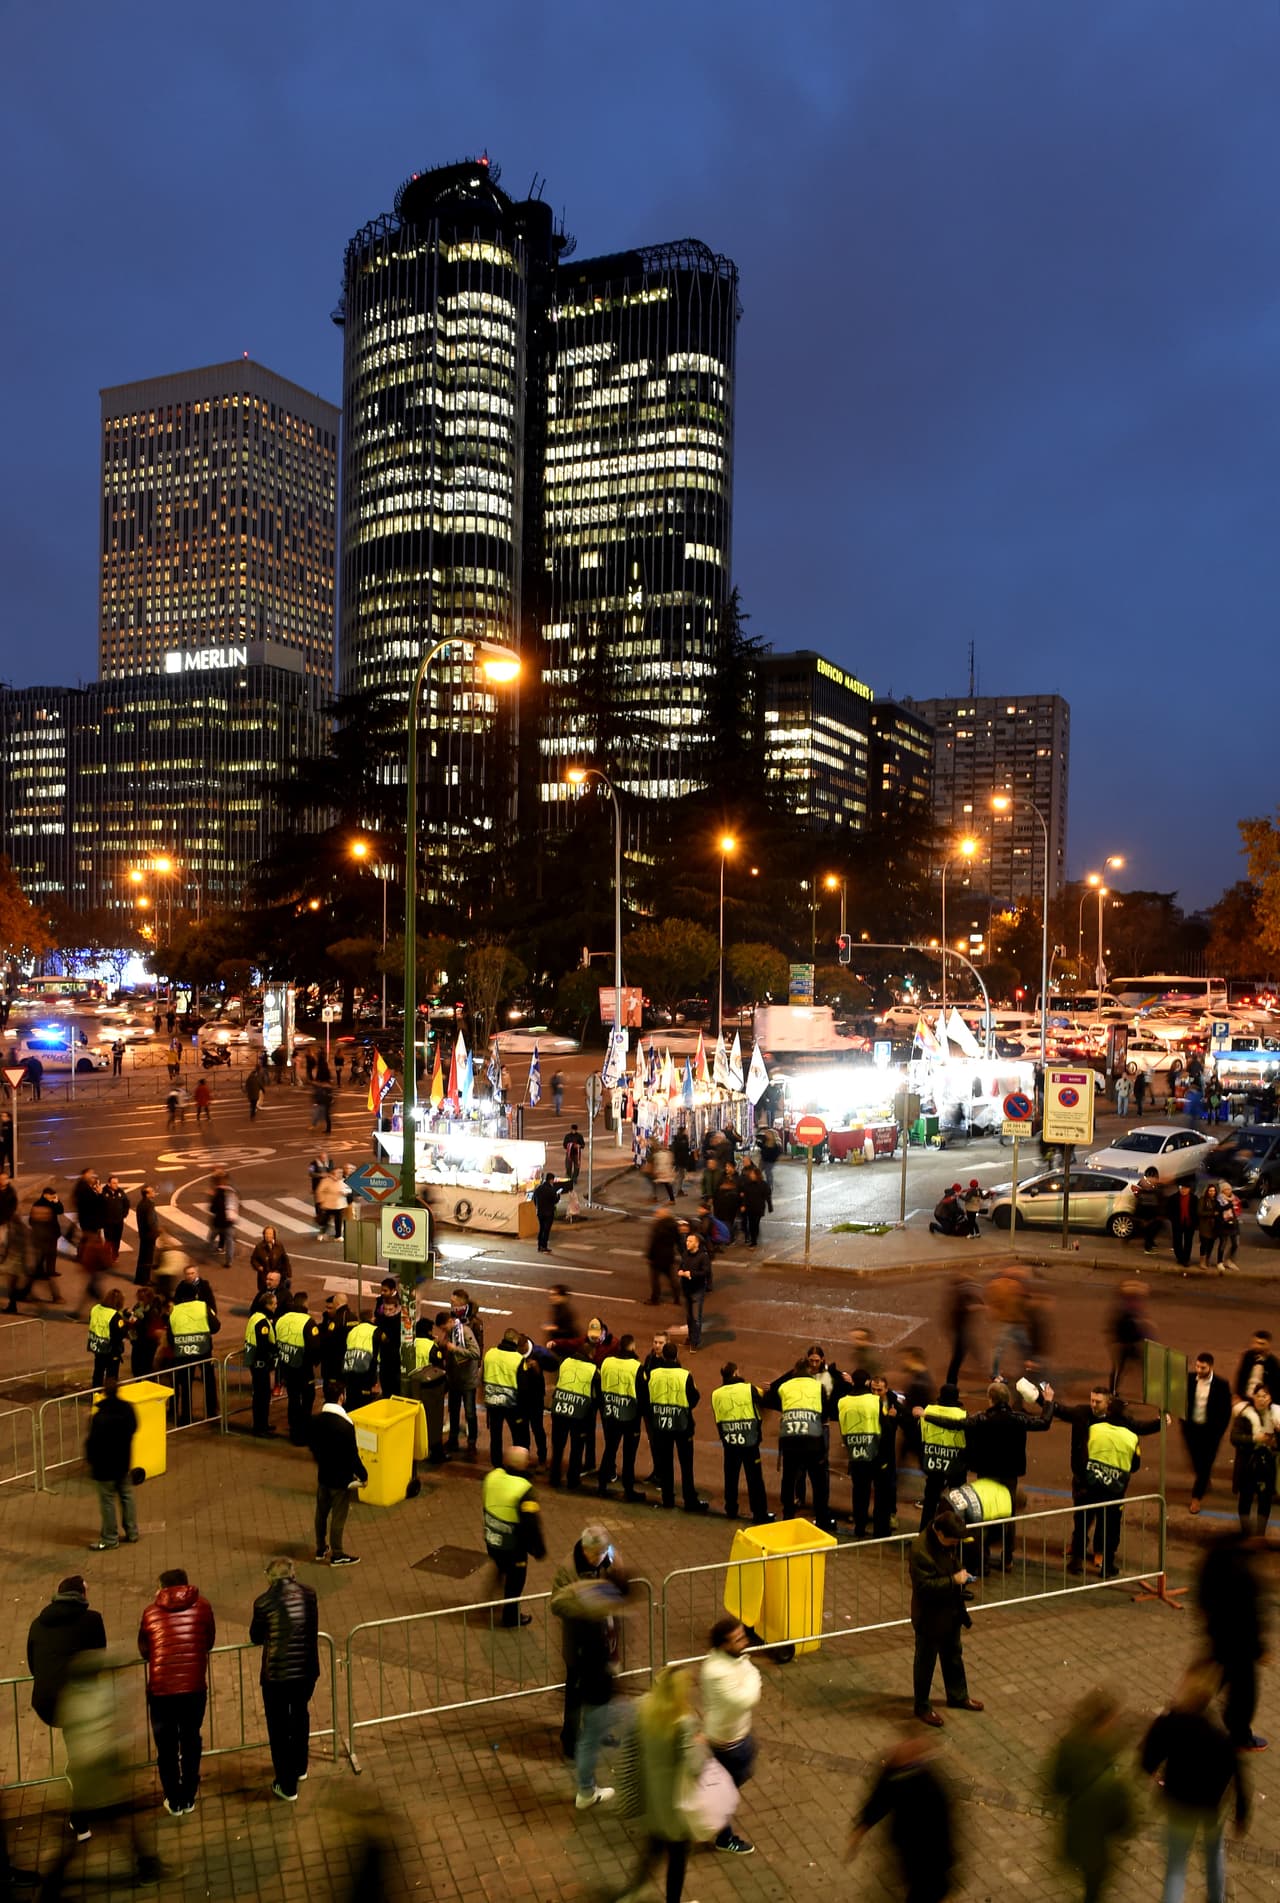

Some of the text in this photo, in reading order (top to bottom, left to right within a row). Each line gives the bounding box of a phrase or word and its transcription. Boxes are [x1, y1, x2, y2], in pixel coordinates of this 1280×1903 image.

[185, 646, 247, 671] MERLIN
[817, 658, 843, 685] EDIFICIO
[1215, 1023, 1226, 1036] P
[369, 1178, 387, 1187] Metro
[174, 1335, 205, 1344] ECURITY
[180, 1344, 200, 1355] 702
[555, 1390, 586, 1407] ECURITY
[555, 1402, 575, 1416] 630
[786, 1421, 809, 1434] 372
[924, 1444, 960, 1459] ECURITY
[927, 1457, 950, 1471] 657
